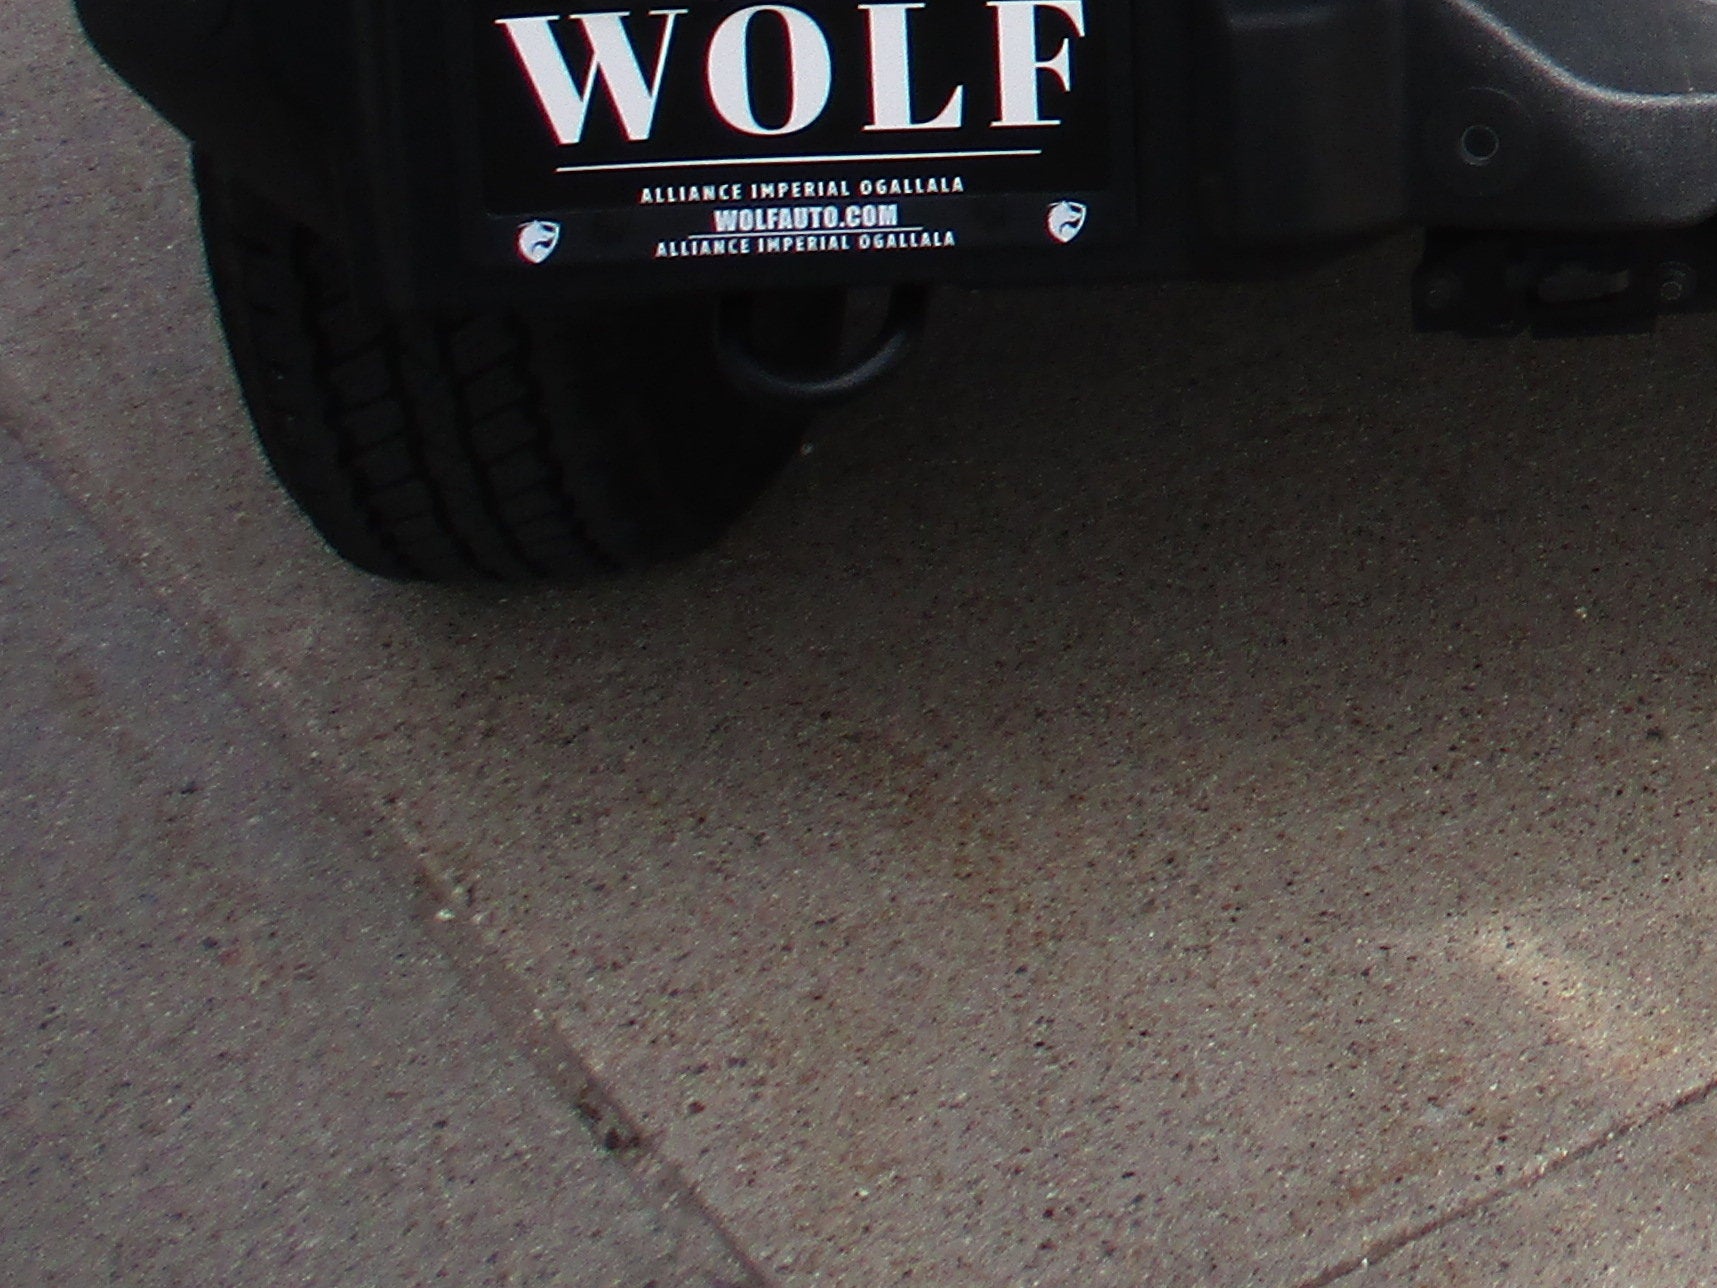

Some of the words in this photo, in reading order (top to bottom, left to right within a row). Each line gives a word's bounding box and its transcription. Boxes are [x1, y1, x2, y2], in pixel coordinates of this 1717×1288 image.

[640, 183, 743, 204] ALLIANCE
[750, 180, 851, 200] IMPERIAL
[859, 176, 964, 196] OGALLALA
[713, 203, 899, 232] WOLFAUTO.COM
[655, 238, 751, 258] ALLIANCE
[757, 234, 850, 254] IMPERIAL
[858, 230, 956, 250] OGALLALA
